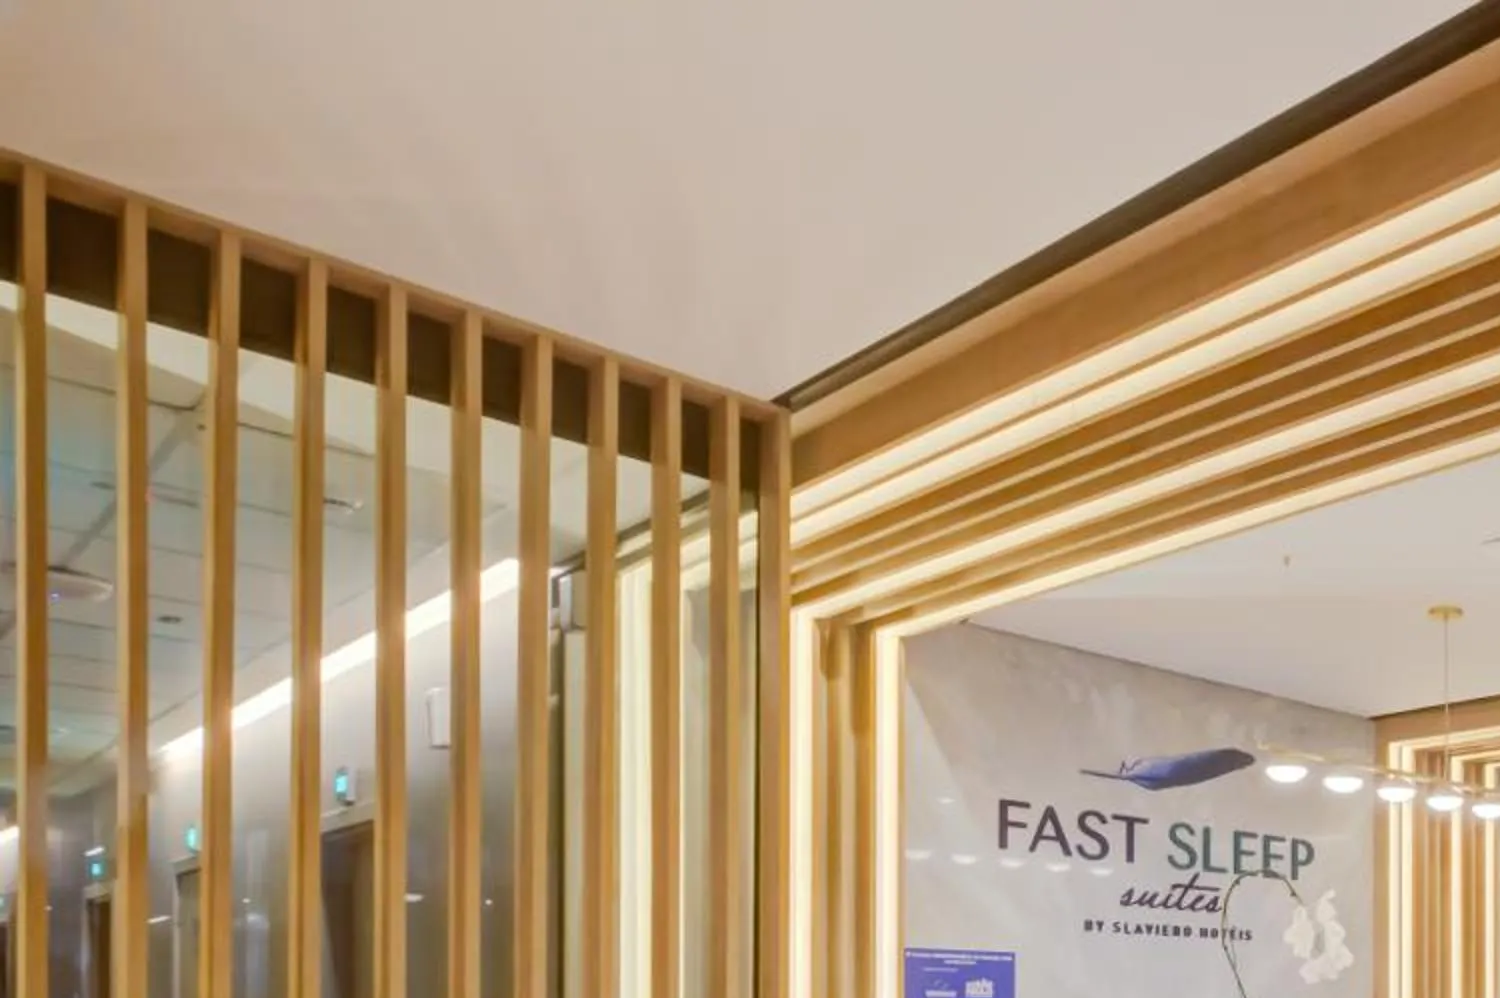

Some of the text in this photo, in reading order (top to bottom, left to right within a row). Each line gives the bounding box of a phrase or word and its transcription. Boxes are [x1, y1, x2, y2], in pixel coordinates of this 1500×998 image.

[998, 798, 1316, 881] FAST SLEEP
[1119, 872, 1223, 914] suites
